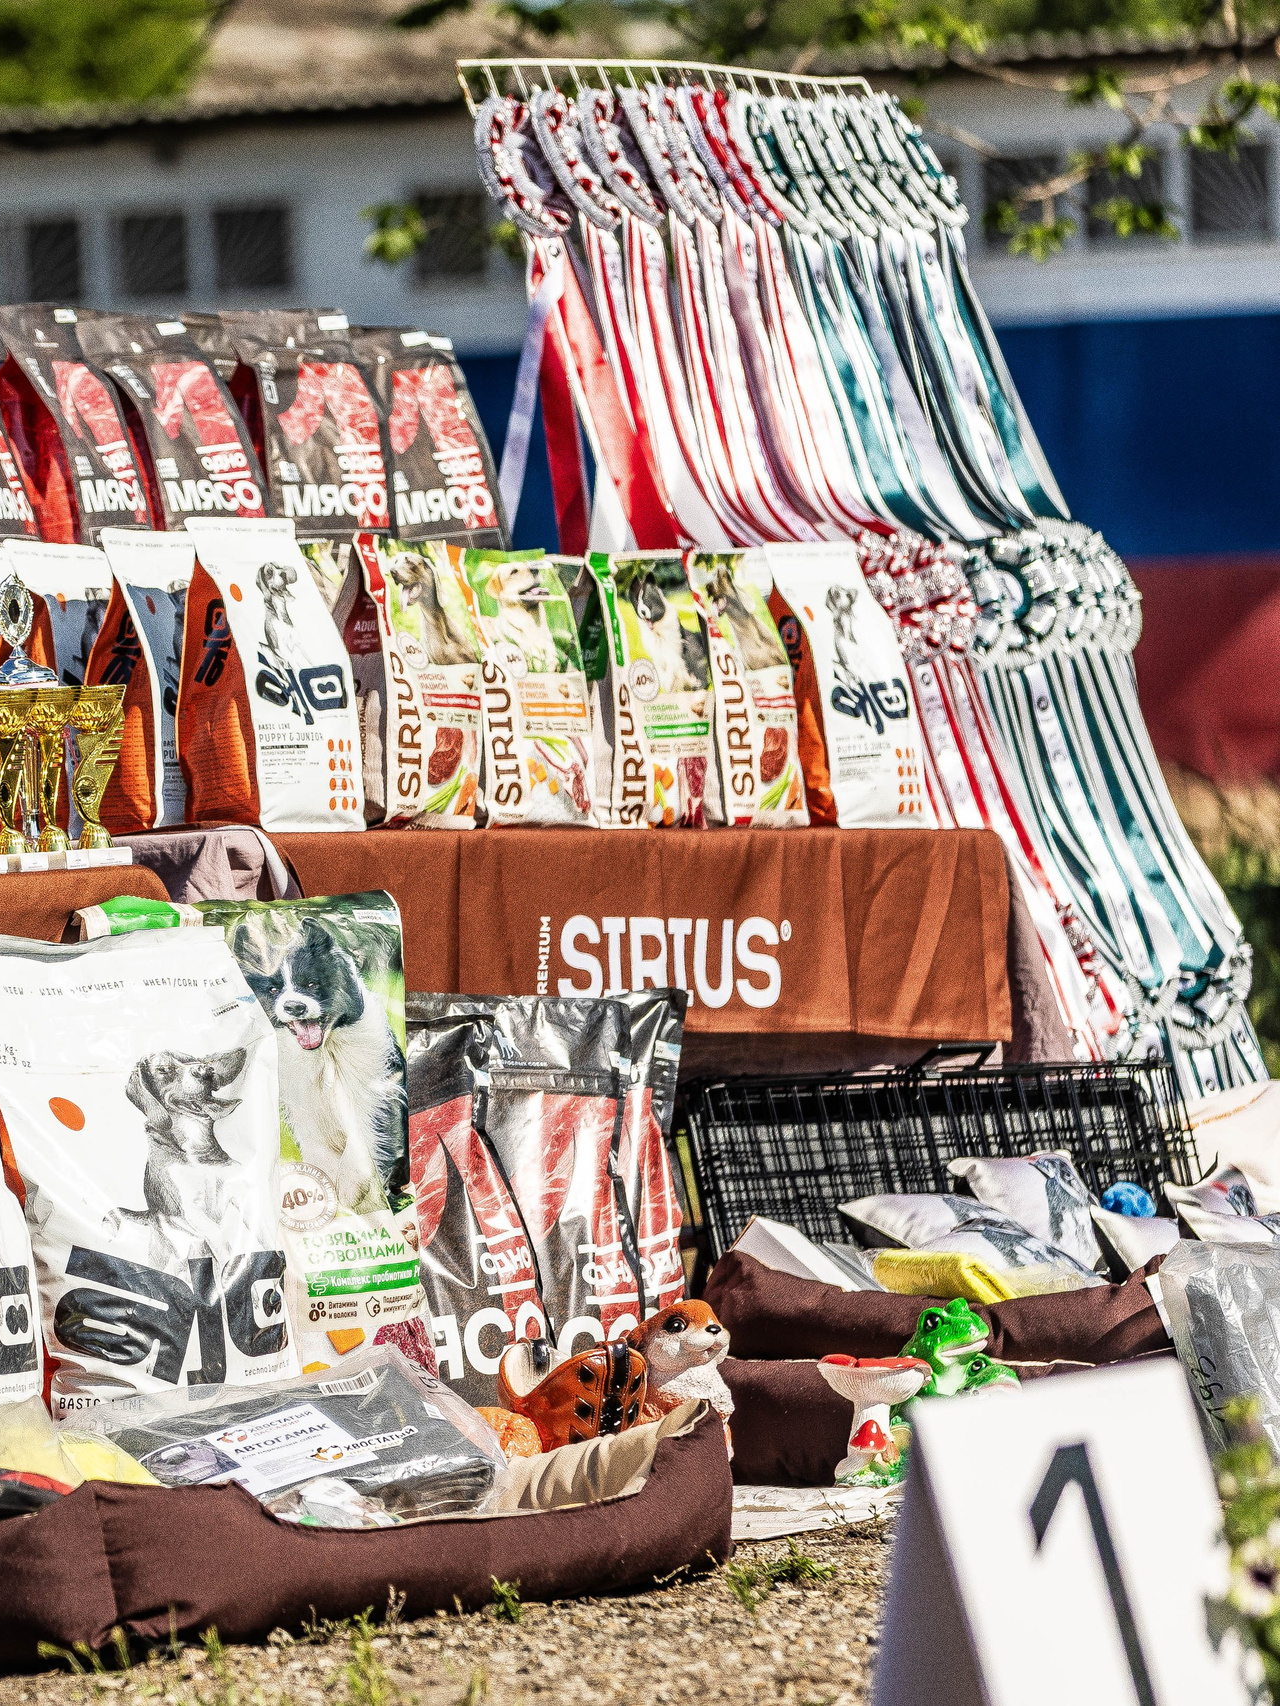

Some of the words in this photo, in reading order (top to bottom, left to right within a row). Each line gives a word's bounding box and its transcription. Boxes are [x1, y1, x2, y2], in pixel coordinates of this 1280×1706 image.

[164, 479, 262, 513] МЯСО
[282, 482, 387, 517] МЯСО
[395, 484, 493, 527] МЯСО
[353, 619, 378, 632] ADUL
[259, 733, 287, 742] PUPPY
[389, 650, 422, 798] SIRIUS
[482, 660, 523, 807] SIRIUS
[716, 652, 755, 796] SIRIUS
[619, 683, 648, 825] SIRIUS
[537, 915, 551, 995] REMIUM
[557, 914, 782, 1009] SIRIUS
[39, 988, 64, 996] WITH
[143, 977, 198, 988] WHEAT/CORN
[204, 977, 228, 987] FREE
[282, 1187, 324, 1211] 40%
[303, 1227, 391, 1249] ГОВЯДИНА
[323, 1242, 405, 1262] ОВОЩАМИ
[331, 1275, 371, 1287] Комплекс
[328, 1300, 358, 1310] Витамины
[248, 1410, 313, 1433] ХВОСТАТЫЙ
[234, 1423, 331, 1454] АВТОГАМАК
[343, 1427, 416, 1452] ХВОСТАТЫЙ
[1029, 1442, 1157, 1706] 1
